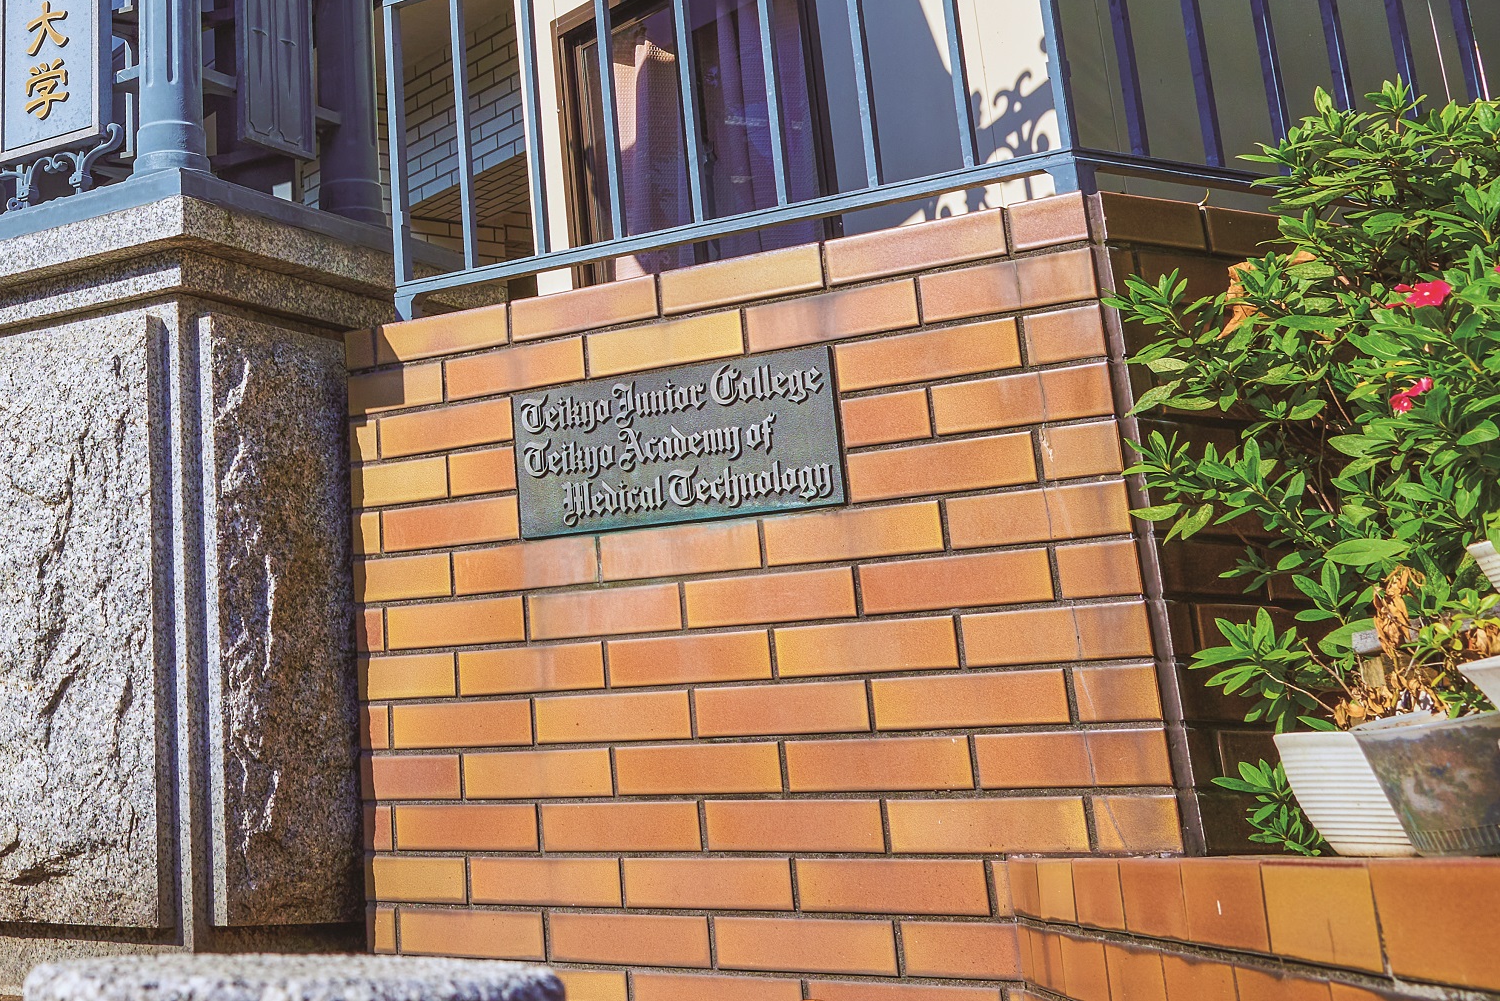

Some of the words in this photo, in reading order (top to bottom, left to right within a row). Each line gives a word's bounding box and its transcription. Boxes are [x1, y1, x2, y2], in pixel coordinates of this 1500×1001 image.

[520, 394, 613, 433] Teikyo
[612, 379, 706, 427] Junior
[710, 364, 825, 406] College
[523, 438, 617, 480] Teikyo
[617, 424, 743, 471] Academy
[745, 412, 777, 454] of
[563, 475, 668, 527] Medical
[668, 460, 834, 508] Technology
